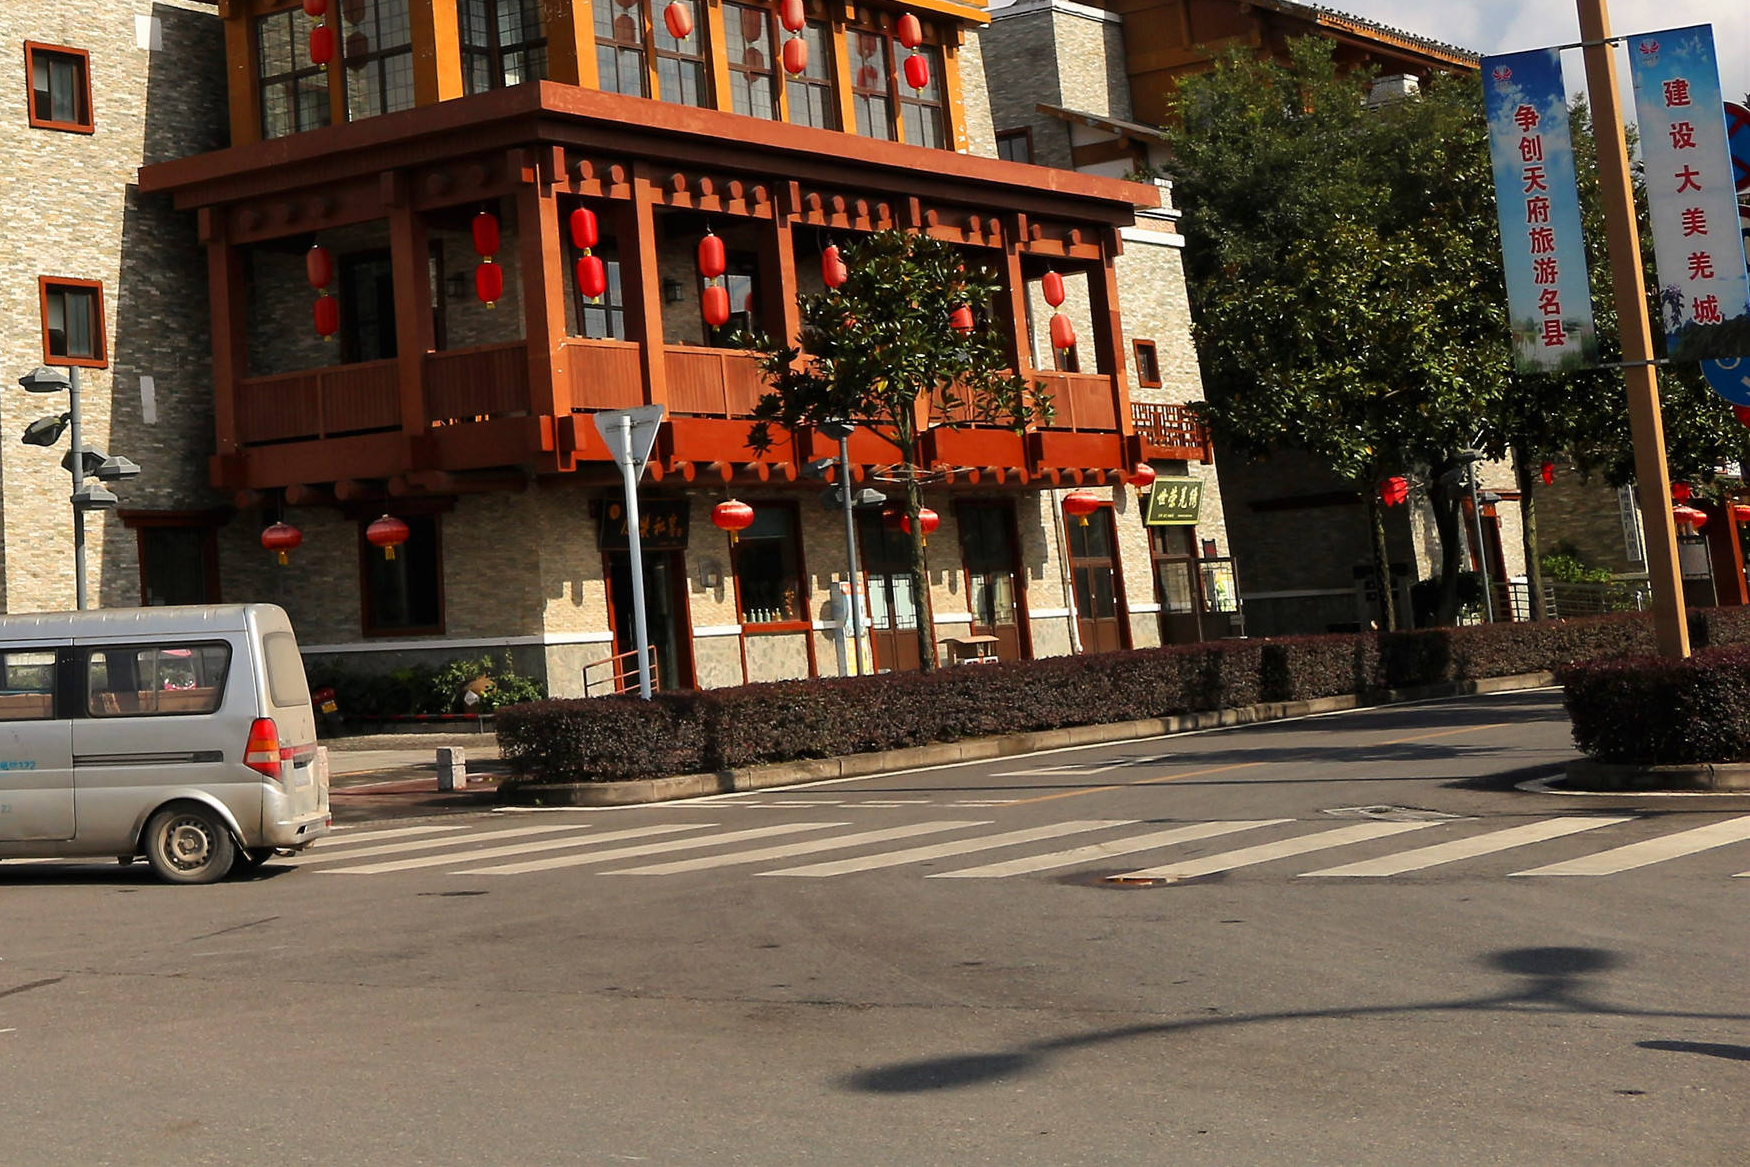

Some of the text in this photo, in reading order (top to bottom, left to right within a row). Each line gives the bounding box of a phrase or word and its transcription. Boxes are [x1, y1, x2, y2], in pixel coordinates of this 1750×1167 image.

[1514, 105, 1567, 348] 争创天府旅游名县
[1662, 78, 1723, 325] 建设大美羌城
